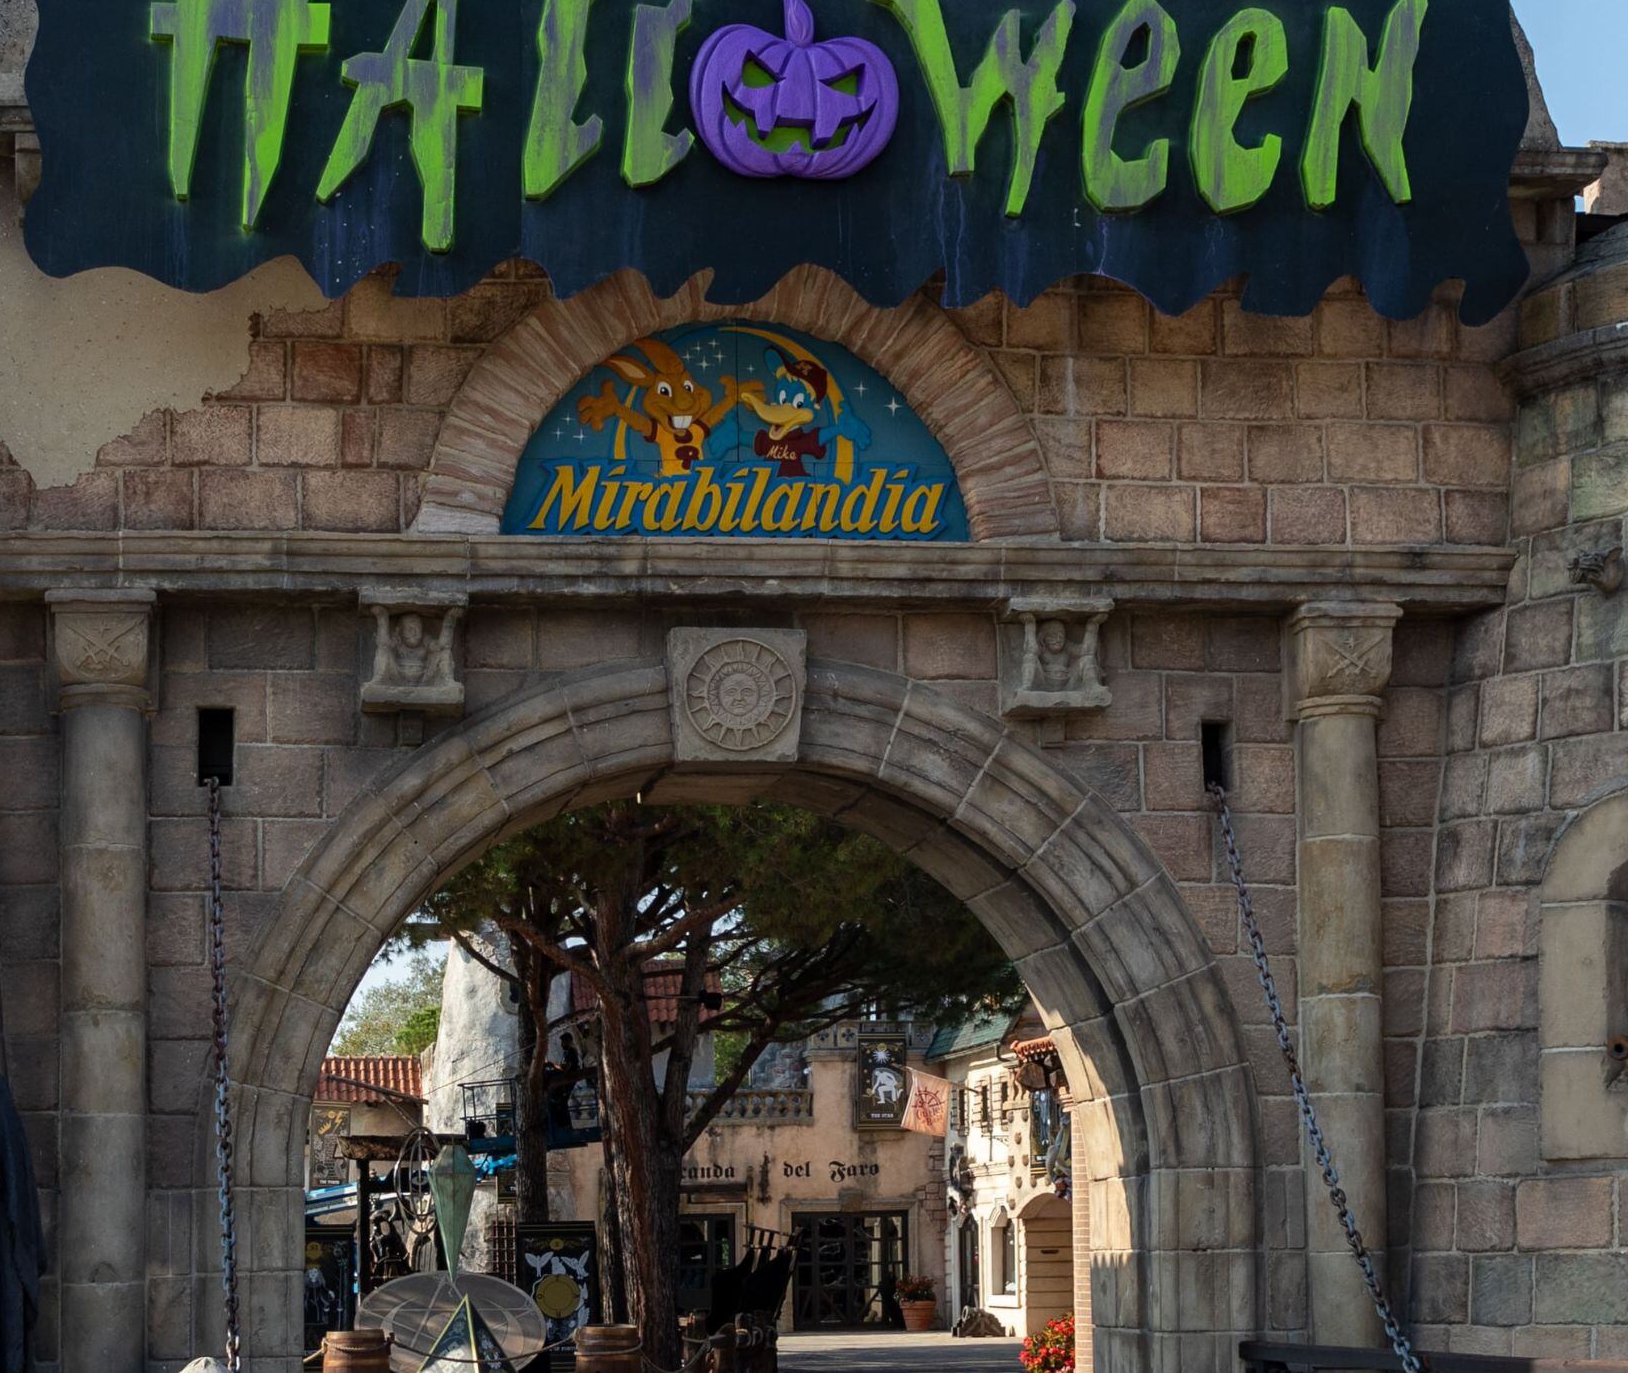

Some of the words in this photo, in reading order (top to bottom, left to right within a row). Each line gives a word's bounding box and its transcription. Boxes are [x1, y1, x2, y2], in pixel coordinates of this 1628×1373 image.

[526, 466, 949, 533] Mirabilandia
[783, 1160, 811, 1178] del
[828, 1160, 880, 1183] Faro
